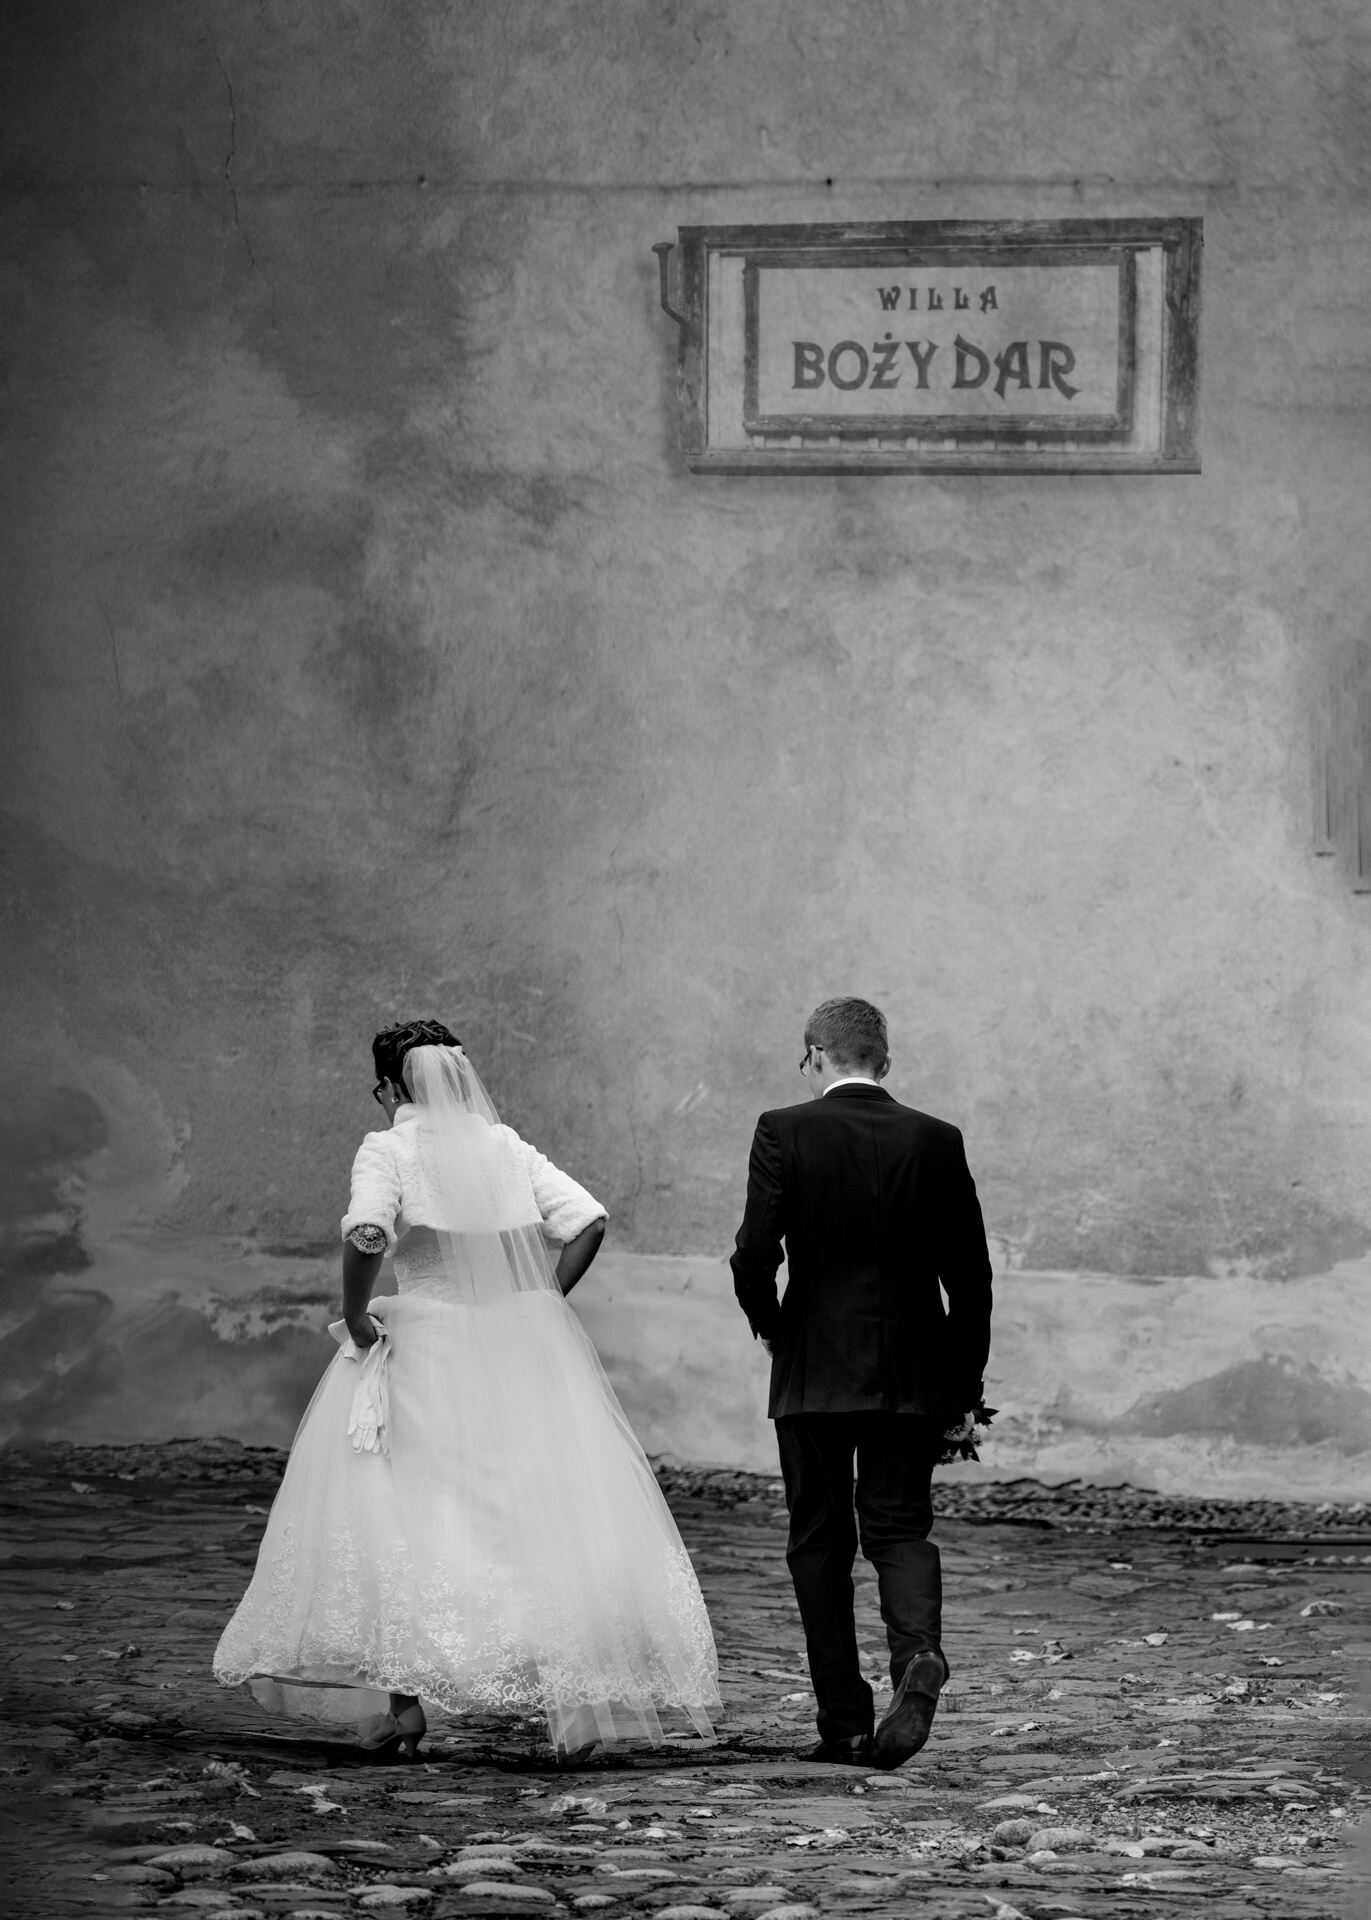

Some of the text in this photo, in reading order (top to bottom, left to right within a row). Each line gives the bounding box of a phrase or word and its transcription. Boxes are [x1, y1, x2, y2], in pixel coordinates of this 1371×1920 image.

[876, 285, 1000, 314] WILLA
[791, 332, 1083, 400] BOŻY DAR
